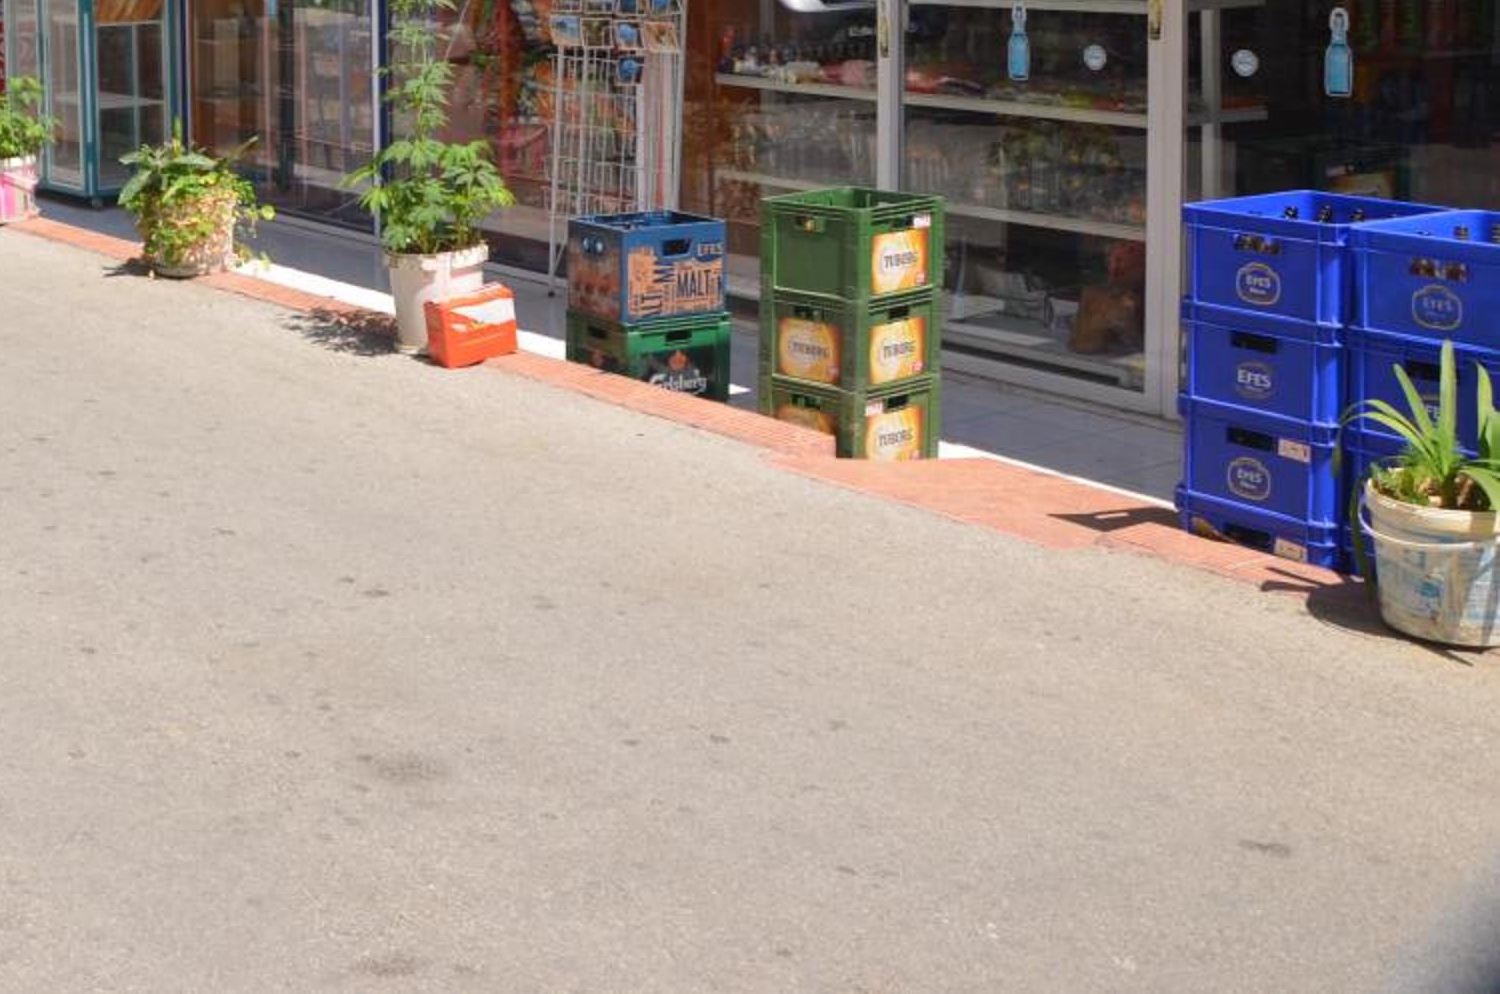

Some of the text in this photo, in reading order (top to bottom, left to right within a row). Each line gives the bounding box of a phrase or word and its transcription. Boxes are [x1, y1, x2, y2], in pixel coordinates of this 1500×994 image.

[883, 251, 918, 270] TUBORG
[677, 268, 711, 299] MALT
[1245, 273, 1272, 289] EFES
[1237, 369, 1272, 388] EFES
